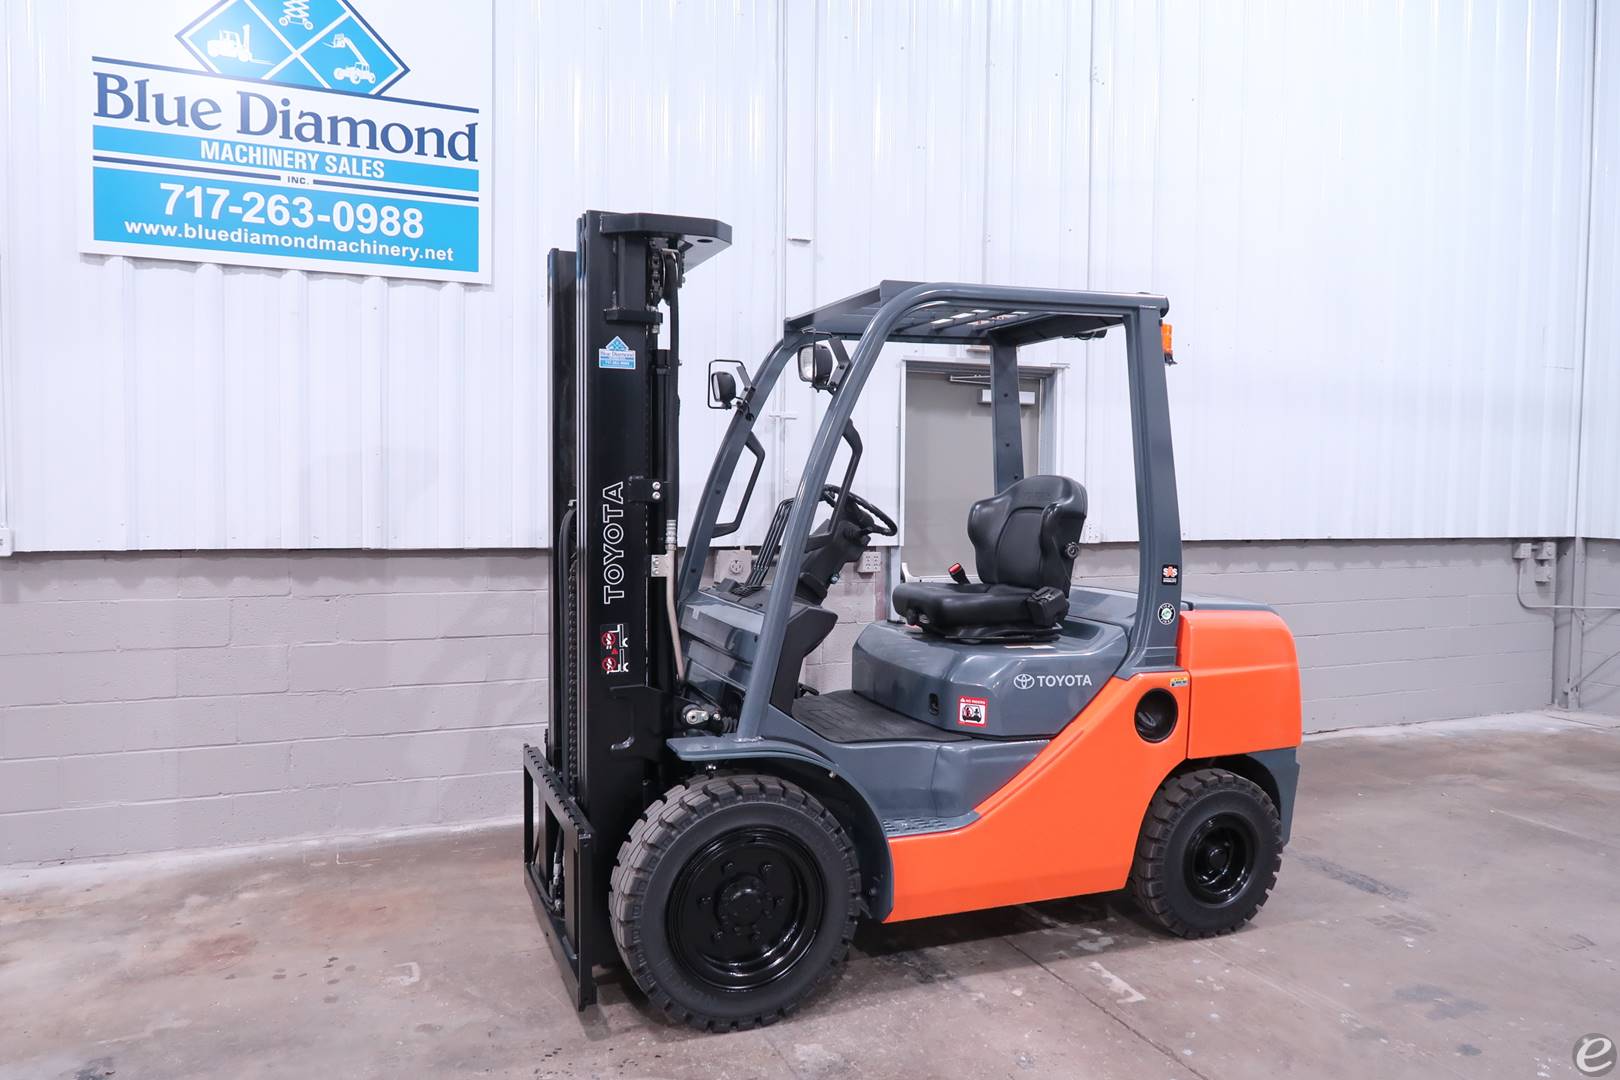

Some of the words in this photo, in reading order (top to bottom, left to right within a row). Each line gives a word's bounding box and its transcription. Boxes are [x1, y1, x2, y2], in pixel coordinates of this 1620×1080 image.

[93, 71, 222, 131] Blue
[236, 90, 479, 162] Diamond
[200, 140, 319, 171] MACHINERY
[324, 155, 385, 179] SALES
[287, 175, 310, 185] INC.
[159, 182, 424, 239] 717-263-0988
[124, 219, 455, 262] www.bluediamondmachinery.net
[603, 481, 625, 604] TOYOTA
[1037, 674, 1093, 688] TOYOTA
